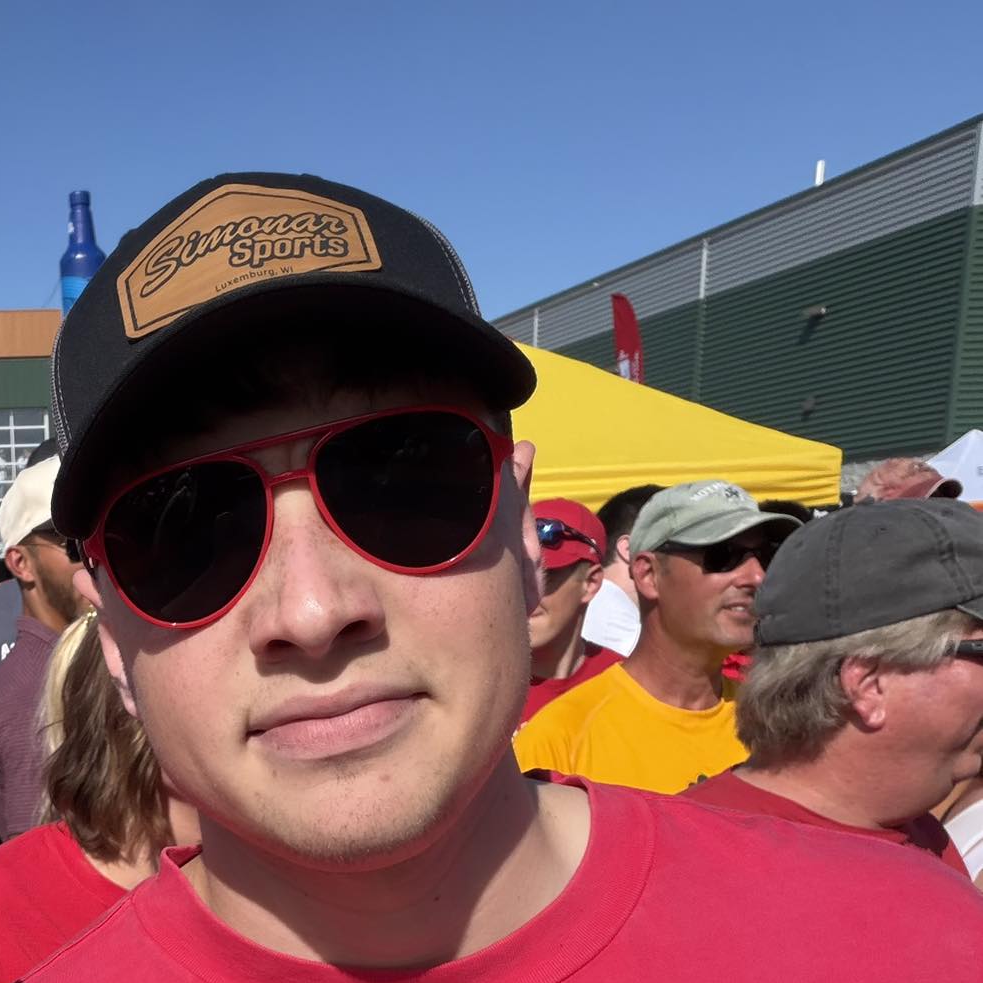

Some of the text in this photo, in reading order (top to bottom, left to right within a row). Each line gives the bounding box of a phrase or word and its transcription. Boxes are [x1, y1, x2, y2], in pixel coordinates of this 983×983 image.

[139, 212, 348, 298] Simonar
[215, 266, 294, 292] Luxemburg, WI
